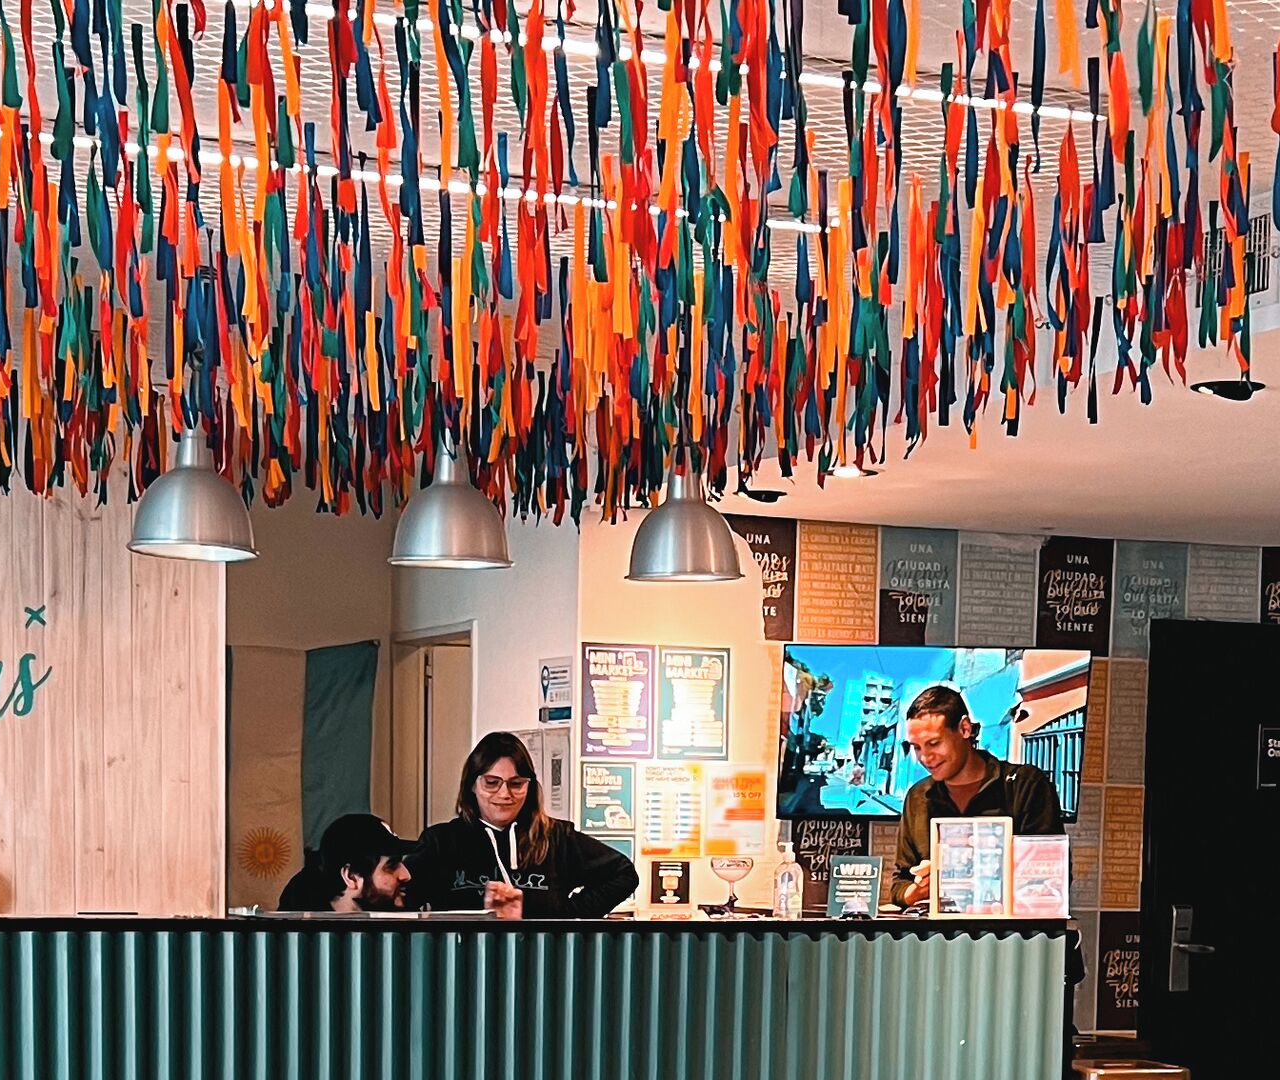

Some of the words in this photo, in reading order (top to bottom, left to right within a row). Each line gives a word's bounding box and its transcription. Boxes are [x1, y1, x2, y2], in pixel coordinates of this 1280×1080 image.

[745, 533, 771, 545] UNA
[909, 543, 933, 554] UNA
[1067, 555, 1089, 565] UNA
[900, 612, 938, 624] SIENTE
[1056, 622, 1094, 632] SIENTE
